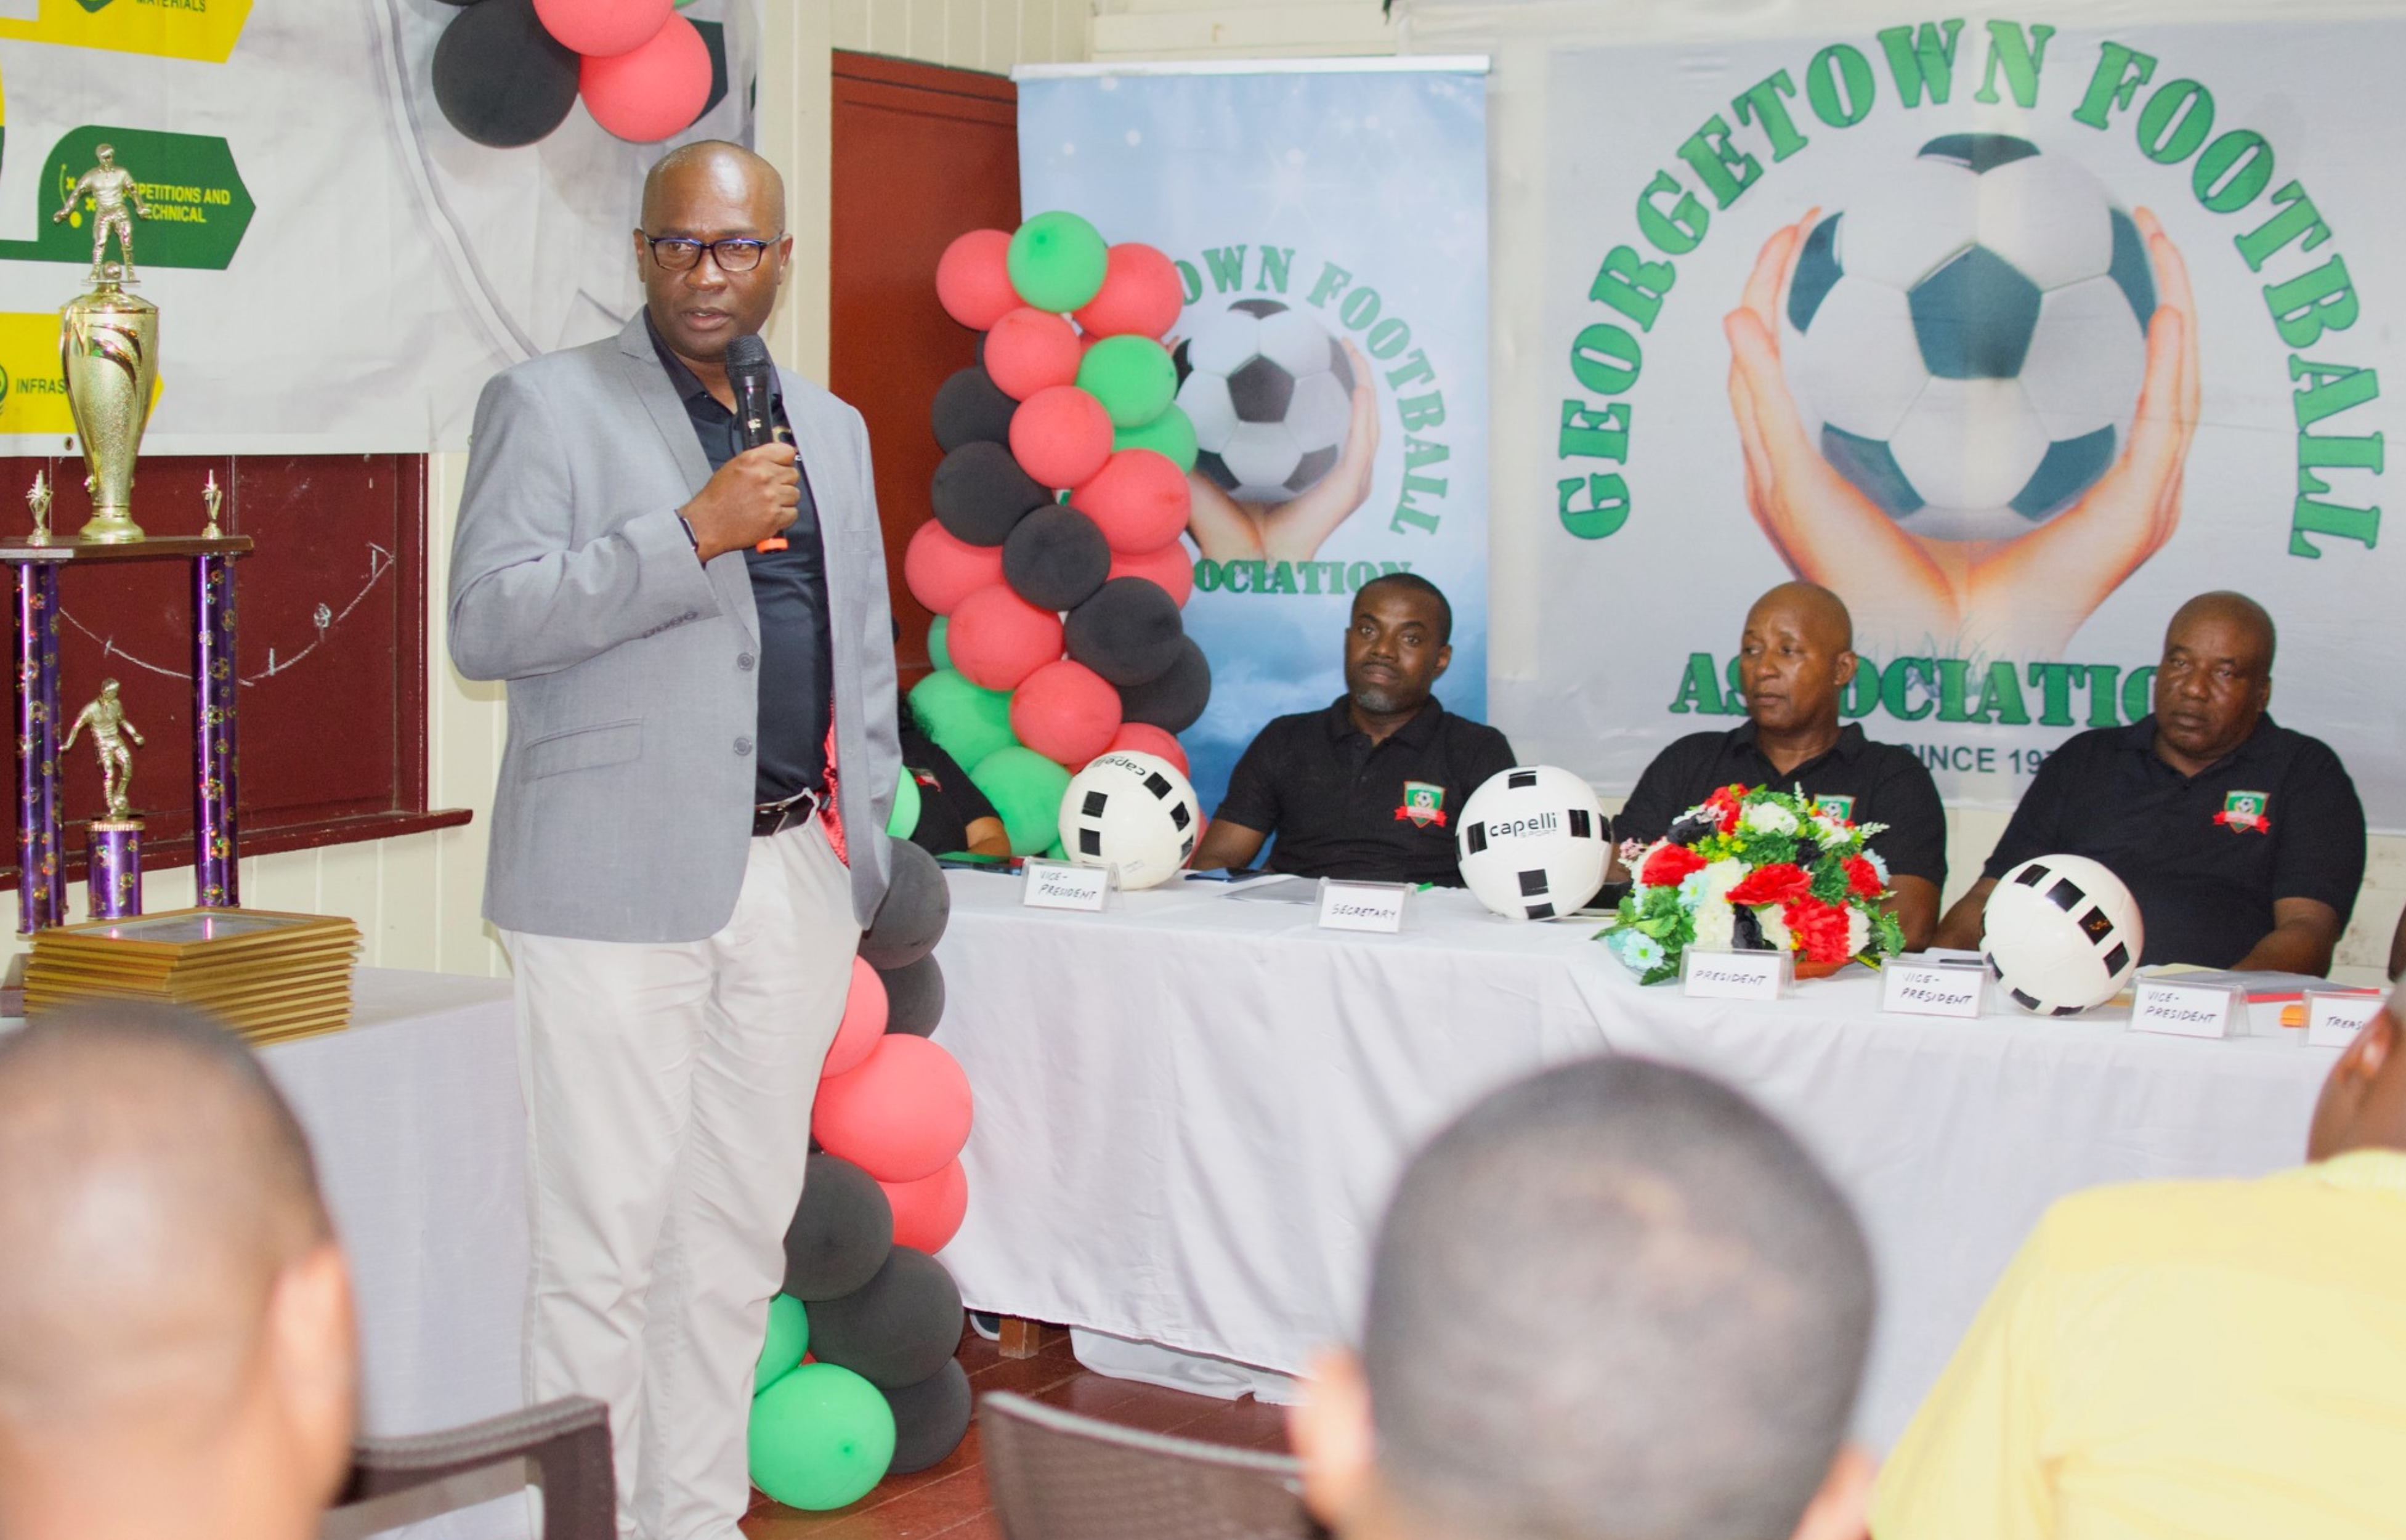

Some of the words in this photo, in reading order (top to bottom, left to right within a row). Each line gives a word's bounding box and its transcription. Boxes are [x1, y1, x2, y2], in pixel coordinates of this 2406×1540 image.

[123, 183, 201, 203] PETITIONS
[203, 188, 230, 205] AND
[147, 203, 207, 222] ECHNICAL
[1558, 18, 2056, 540] GEORGETOWN
[2072, 41, 2384, 560] FOOTBALL
[16, 378, 66, 394] INFRAS
[1174, 243, 1296, 306] OWN
[1305, 261, 1450, 535] FOOTBALL
[1193, 559, 1413, 594] OCIATIO
[1667, 652, 2160, 728] AOCIATIO
[1902, 744, 1996, 773] INCE
[2009, 748, 2056, 774] 19
[1489, 812, 1557, 837] capelli
[1037, 883, 1096, 900] PRESIDENT
[1331, 903, 1396, 920] SECRETARY
[1693, 970, 1767, 986] PRESIDENT
[1899, 987, 1973, 1005] PRESIDENT
[2144, 1005, 2218, 1023] PRESIDENT
[2326, 1016, 2366, 1030] TREAS
